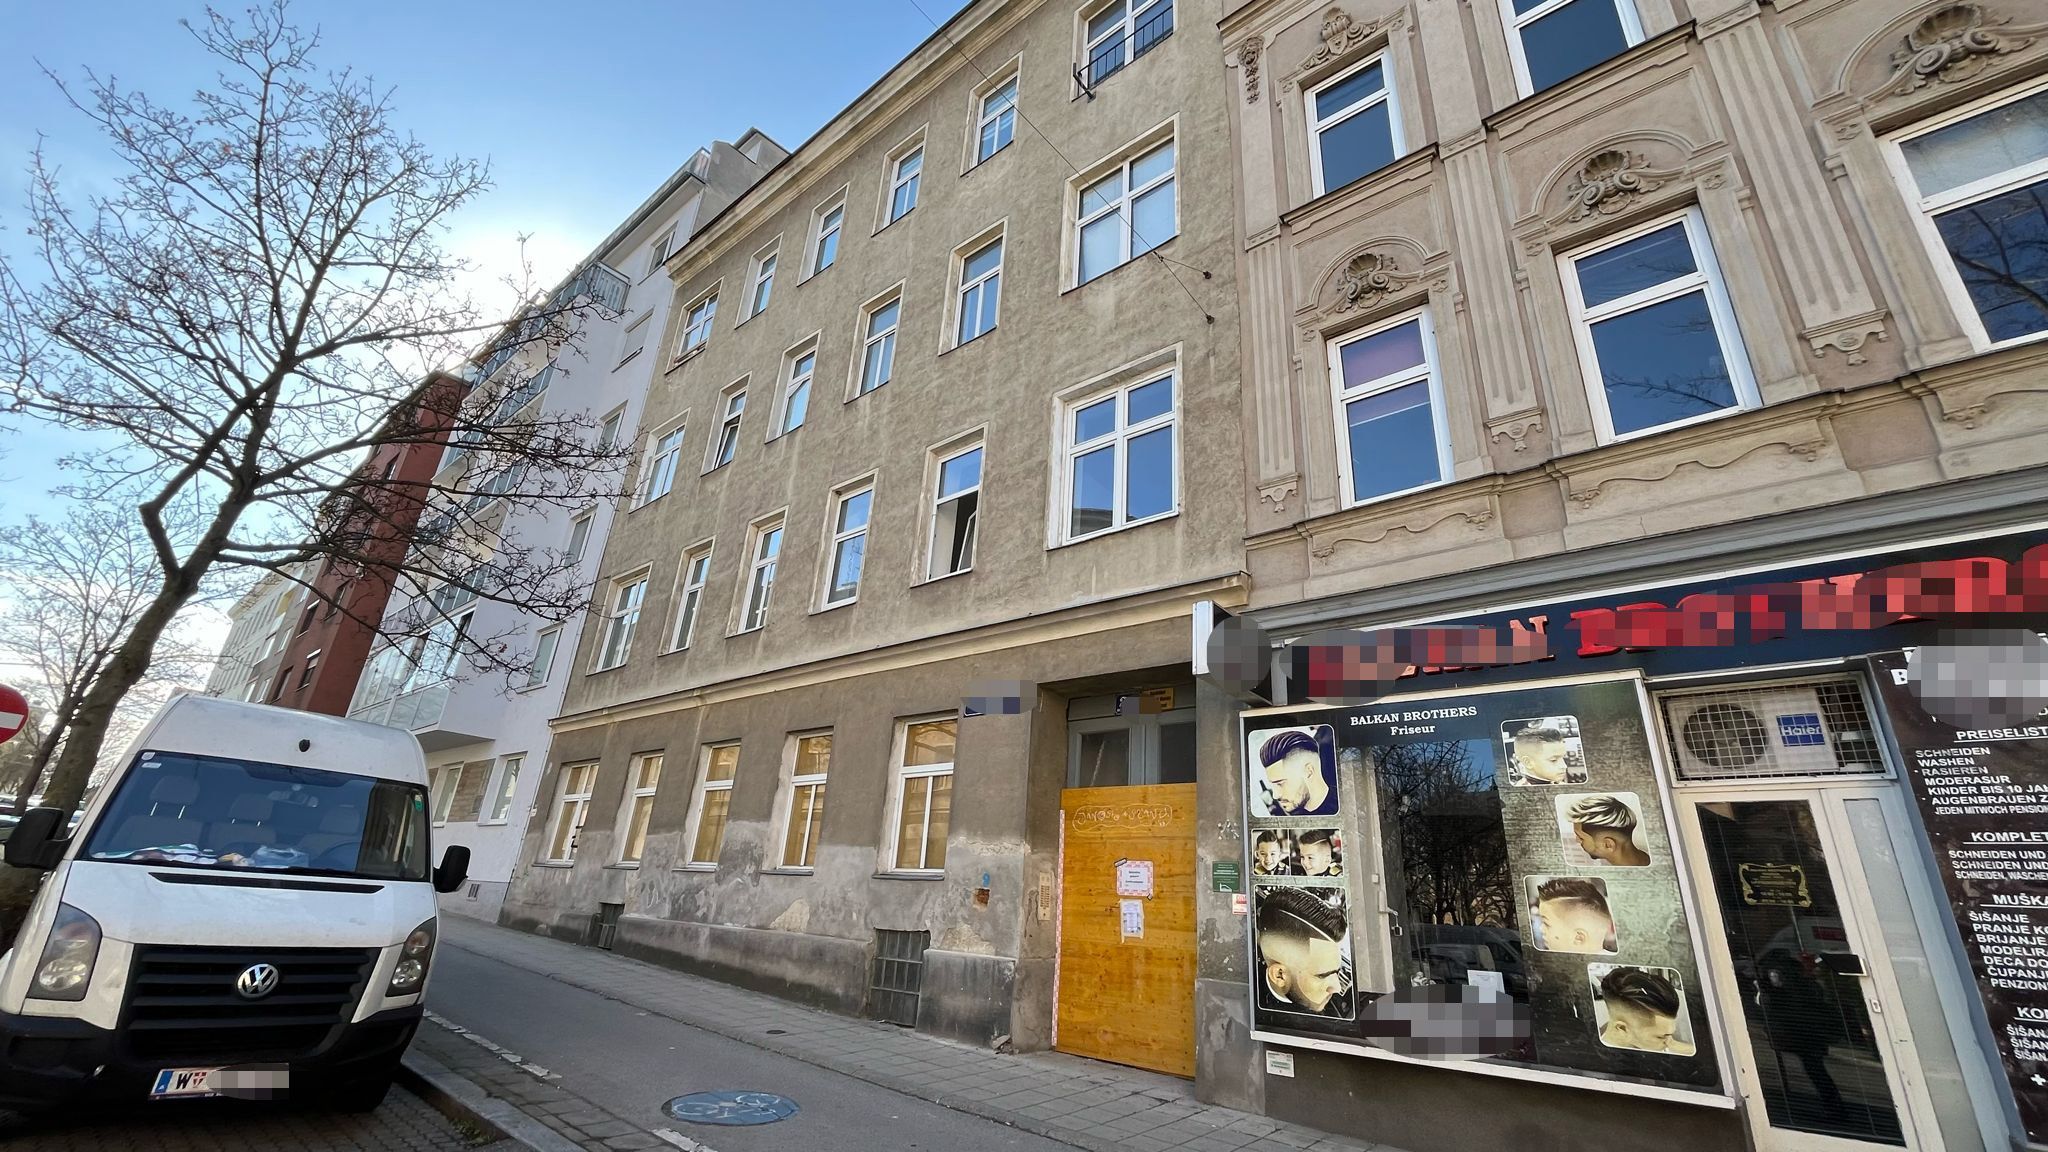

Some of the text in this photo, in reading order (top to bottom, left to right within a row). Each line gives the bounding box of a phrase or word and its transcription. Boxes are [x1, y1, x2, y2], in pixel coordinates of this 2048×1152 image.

[1350, 706, 1477, 726] BALKAN BROTHERS
[1390, 725, 1436, 736] Friseur
[1915, 747, 1991, 758] SCHNEIDEN
[1917, 757, 1975, 767] WASHEN
[1922, 766, 1989, 776] RASIEREN
[1924, 775, 2012, 786] MODERASUR
[1928, 786, 1979, 795] KINDER
[1981, 785, 2004, 794] BIS
[2007, 785, 2023, 793] 10
[1931, 795, 2037, 805] AUGENBRAUEN
[1934, 806, 1963, 815] JEDEN
[1964, 806, 2008, 814] MITWOCH
[1948, 850, 2046, 859] SCHNEIDEN UND
[1952, 860, 2022, 870] SCHNEIDEN
[1968, 910, 2030, 923] ŠIŠANJE
[1972, 923, 2031, 935] PRANJE
[1975, 933, 2048, 946] BRIJANJE
[1979, 945, 2048, 957] MODELIR
[1983, 955, 2048, 969] DECA DO
